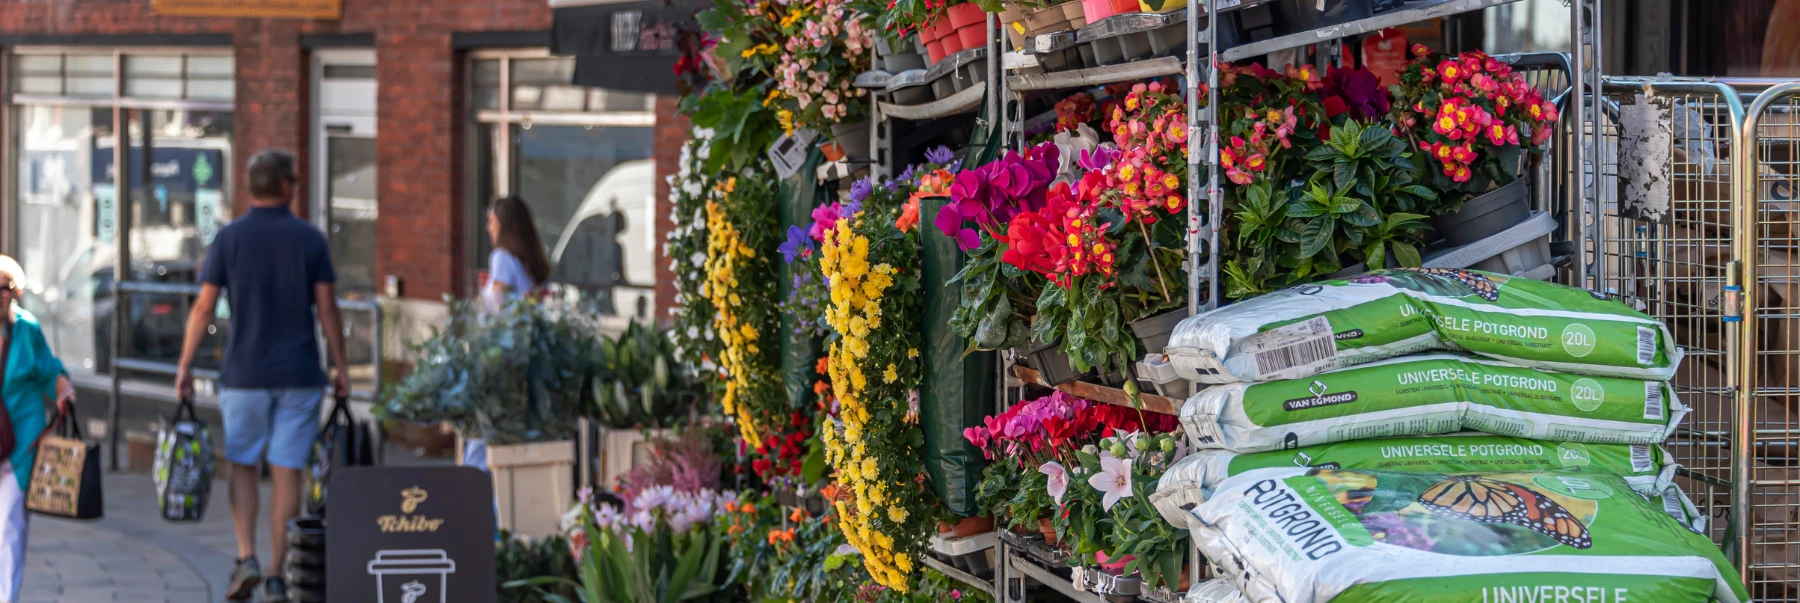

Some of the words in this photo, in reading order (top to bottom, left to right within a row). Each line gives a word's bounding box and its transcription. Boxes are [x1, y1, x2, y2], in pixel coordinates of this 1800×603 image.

[1473, 318, 1548, 340] POTGROND
[1566, 331, 1592, 347] 20L
[1397, 369, 1480, 386] UNIVERSELE
[1483, 373, 1557, 393] POTGROND
[1288, 400, 1309, 409] VAN
[1311, 394, 1351, 406] EGMOND
[1575, 385, 1600, 401] 20L
[1380, 444, 1467, 459] UNIVERSELE
[1469, 444, 1544, 457] POTGROND
[376, 515, 445, 533] Tchibo
[1243, 478, 1342, 561] POTGROND
